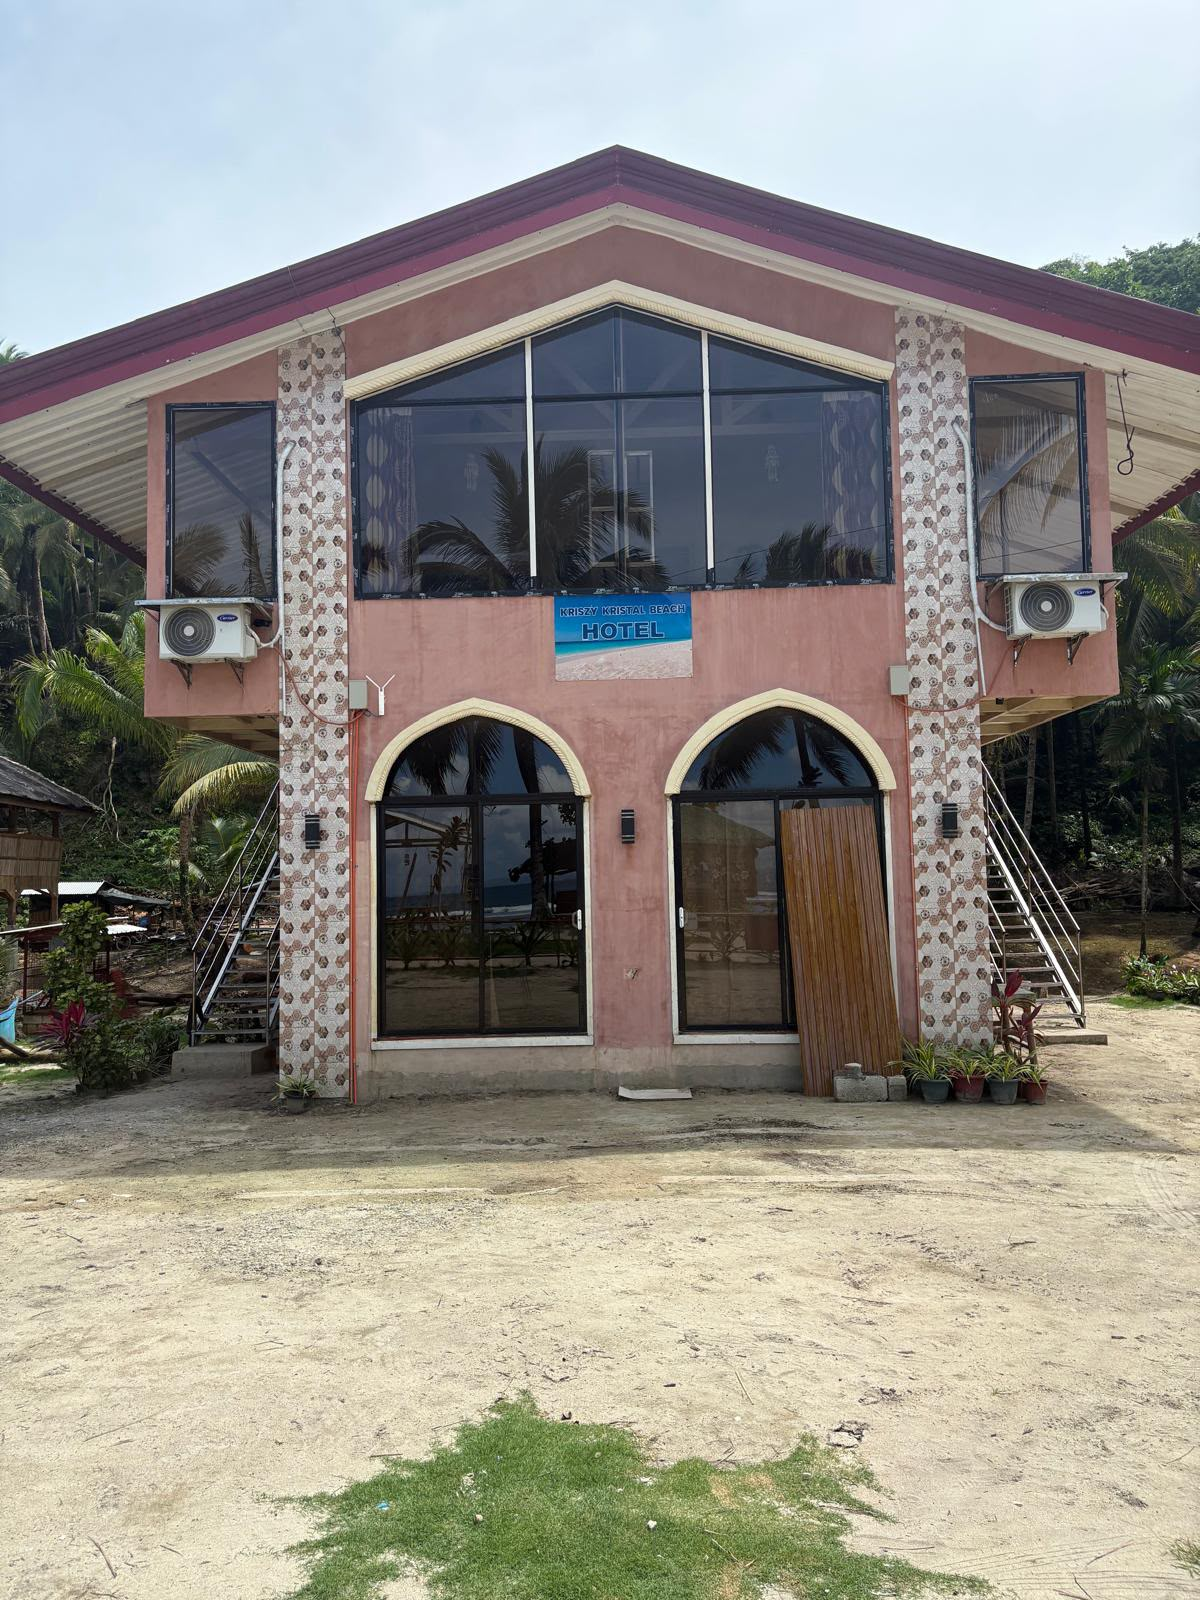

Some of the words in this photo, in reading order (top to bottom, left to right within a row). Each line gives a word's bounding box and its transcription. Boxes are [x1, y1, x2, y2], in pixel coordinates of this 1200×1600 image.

[560, 607, 598, 617] KRISZY
[602, 605, 646, 616] KRISTAL
[649, 604, 686, 614] BEACH
[581, 621, 665, 640] HOTEL
